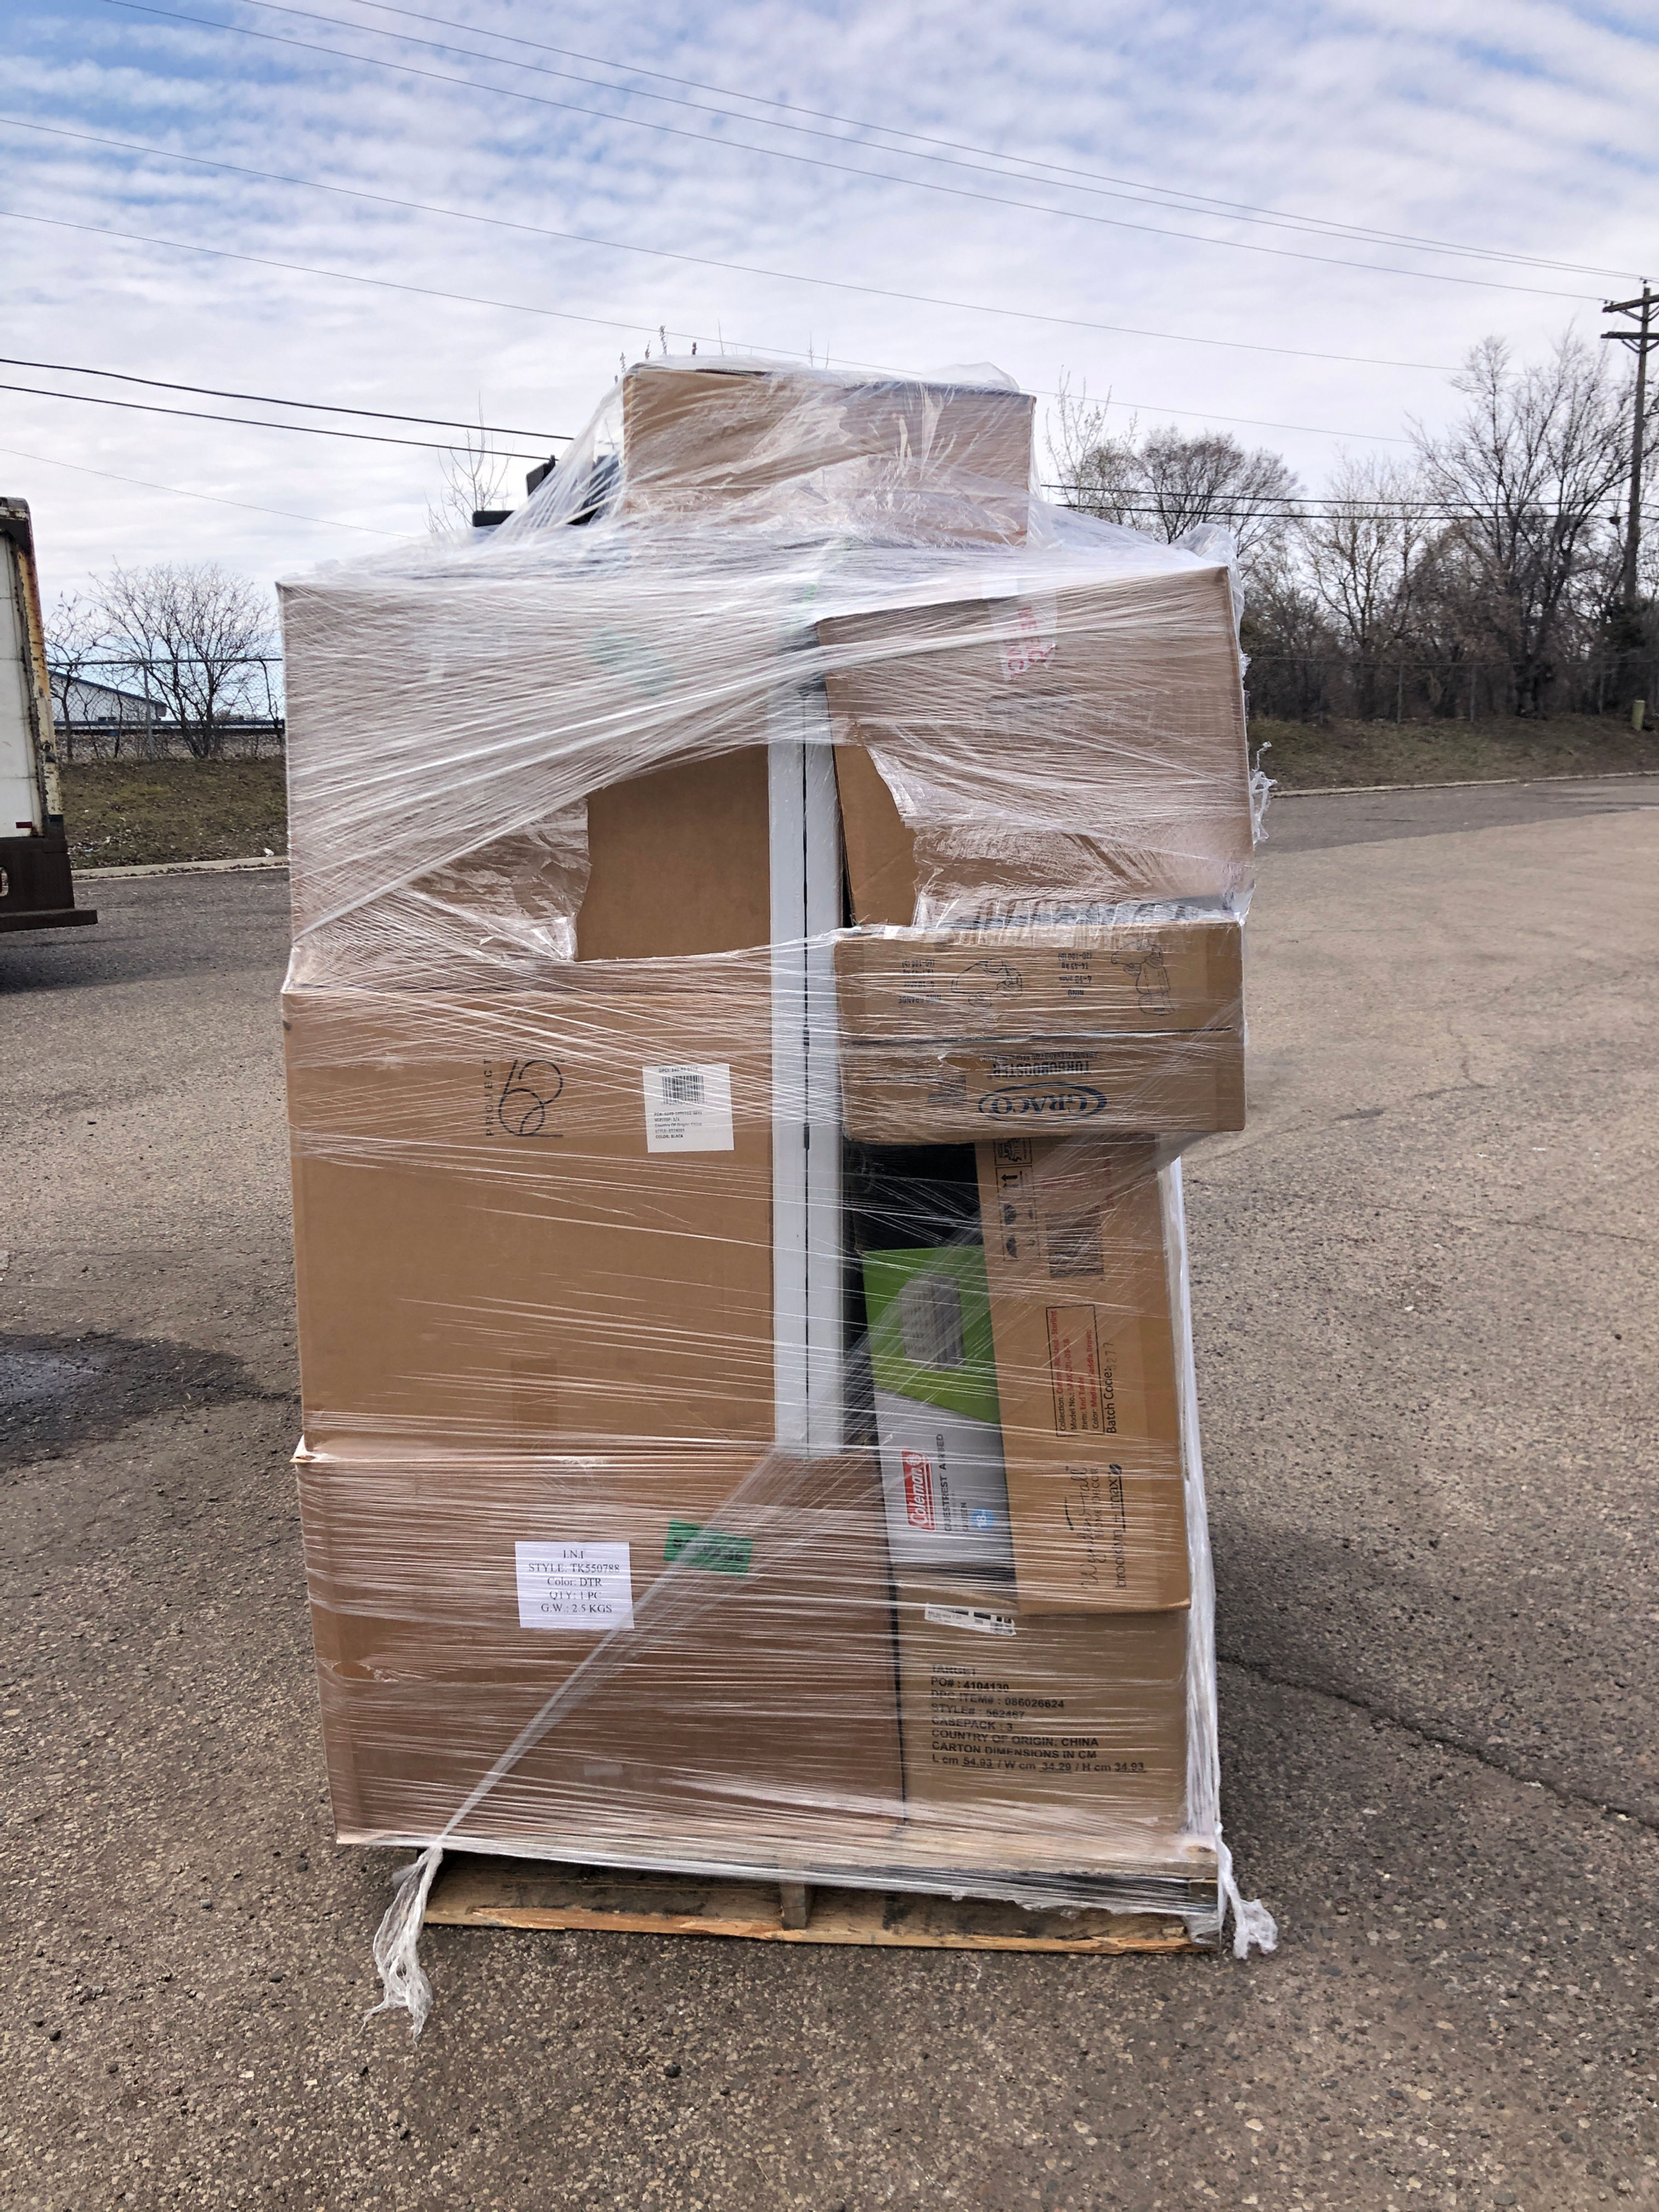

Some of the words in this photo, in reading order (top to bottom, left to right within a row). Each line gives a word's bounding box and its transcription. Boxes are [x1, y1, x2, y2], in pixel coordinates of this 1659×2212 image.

[483, 1058, 494, 1137] PROJECT
[992, 1094, 1087, 1114] GRACO
[1049, 1310, 1058, 1335] Sterling
[1077, 1377, 1086, 1395] Table
[1090, 1379, 1098, 1407] Medium
[1103, 1368, 1114, 1400] Code:
[1058, 1395, 1066, 1431] Collection:
[1069, 1408, 1077, 1430] Model
[1104, 1403, 1116, 1434] Batch
[909, 1468, 928, 1525] Coleman
[528, 1564, 568, 1572] STYLE:
[570, 1564, 620, 1573] TK550788
[1112, 1530, 1126, 1589] brooklyn
[548, 1577, 576, 1586] Color:
[579, 1577, 603, 1587] DTR
[572, 1604, 586, 1613] 2.5
[589, 1604, 612, 1613] KGS
[931, 1677, 955, 1687] PO#
[931, 1703, 975, 1715] STYLE#
[932, 1717, 996, 1730] CASEPACK
[1006, 1722, 1013, 1731] 3
[932, 1730, 988, 1742] COUNTRY
[992, 1734, 1008, 1743] OF
[1012, 1735, 1058, 1746] ORIGIN:
[1062, 1737, 1099, 1747] CHINA
[932, 1741, 981, 1753] CARTON
[985, 1746, 1059, 1759] DIMENSIONS
[1063, 1750, 1075, 1759] IN
[1079, 1750, 1097, 1759] CM
[942, 1757, 958, 1765] cm
[1004, 1760, 1016, 1769] W
[1082, 1763, 1091, 1771] H
[1094, 1764, 1111, 1772] cm
